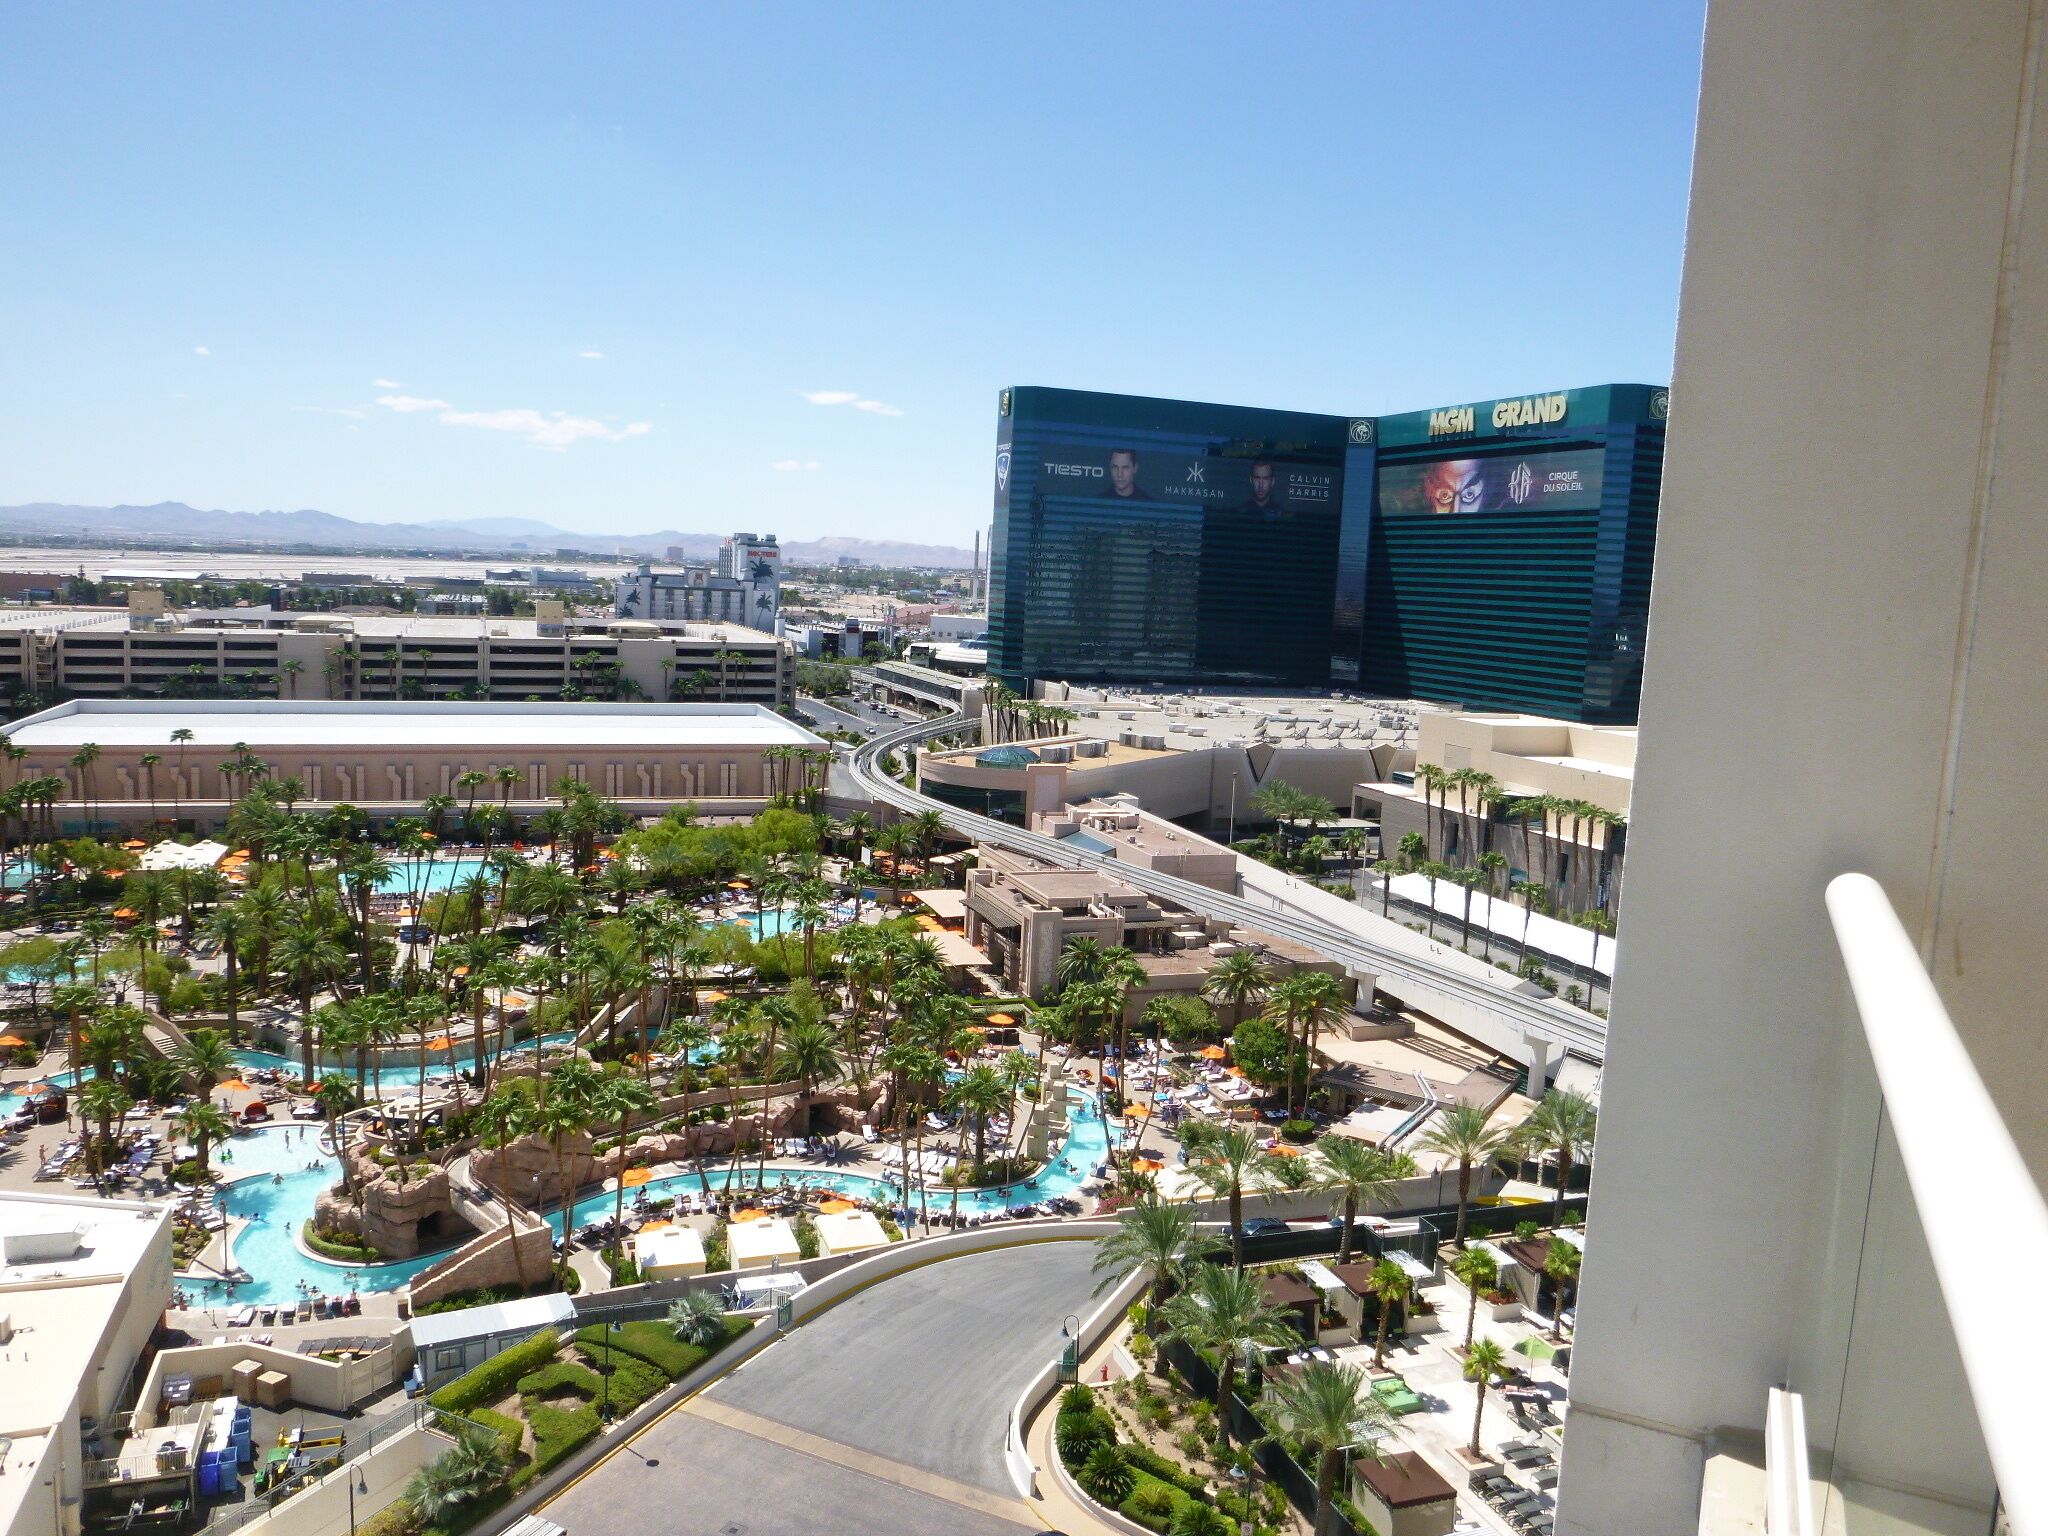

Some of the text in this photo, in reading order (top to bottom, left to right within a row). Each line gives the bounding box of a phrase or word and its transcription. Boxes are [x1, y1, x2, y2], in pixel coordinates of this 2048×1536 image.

[1429, 396, 1566, 436] MGM GRAND
[1289, 474, 1329, 484] CALVIN
[1548, 471, 1578, 482] CIRQUE
[1165, 486, 1224, 498] HAKKASAN
[1288, 488, 1328, 497] HARRIS
[1543, 482, 1582, 493] DU SOLEIL
